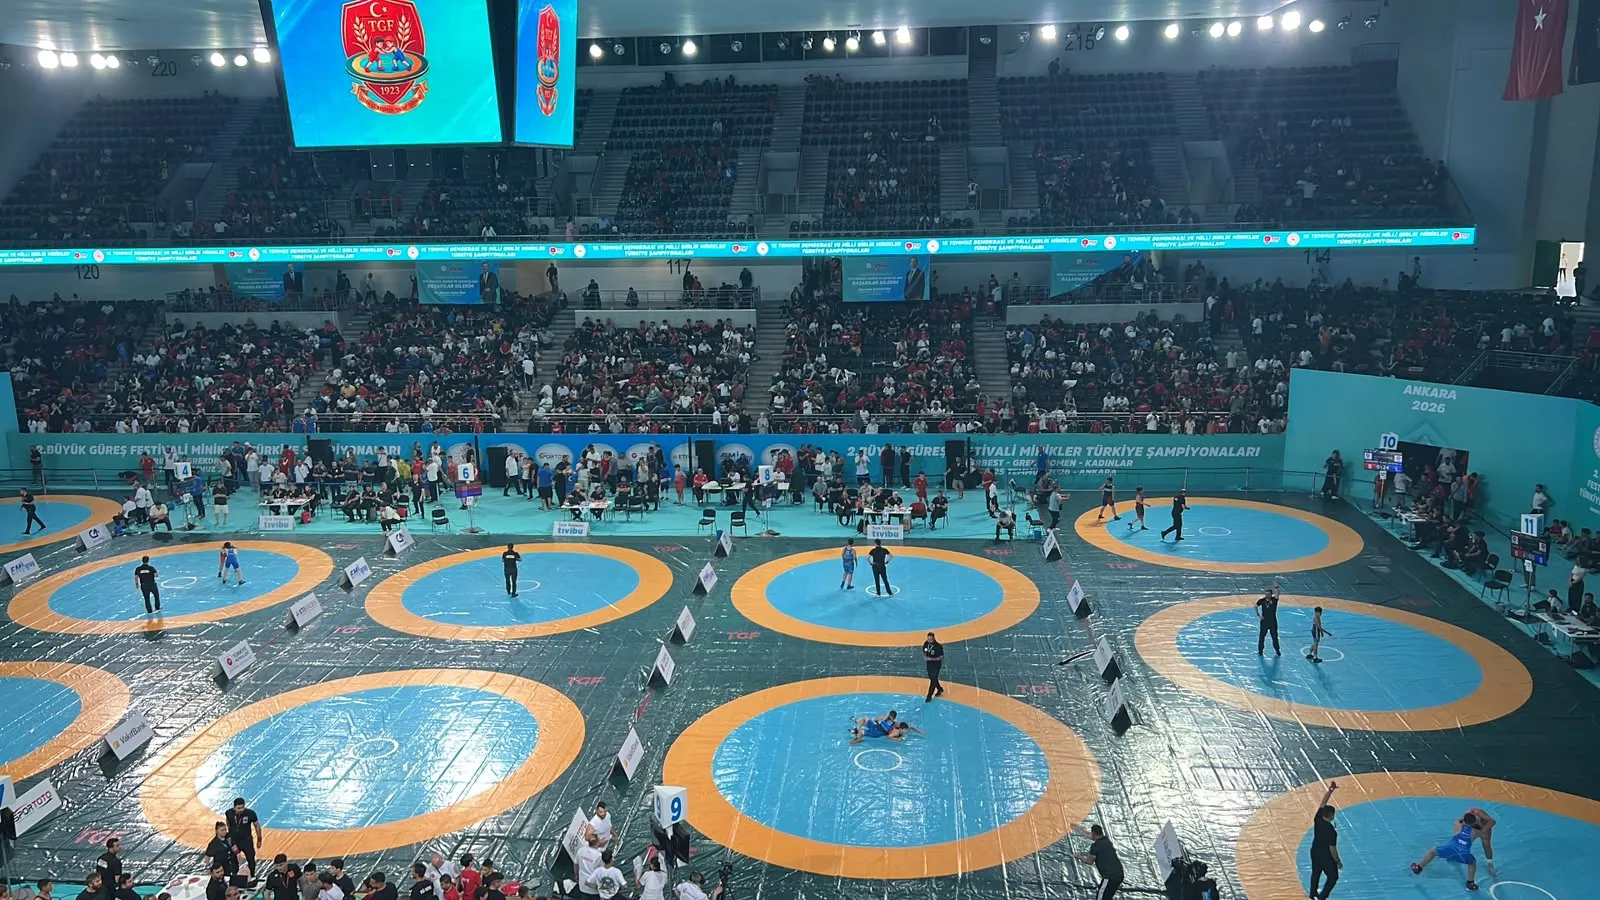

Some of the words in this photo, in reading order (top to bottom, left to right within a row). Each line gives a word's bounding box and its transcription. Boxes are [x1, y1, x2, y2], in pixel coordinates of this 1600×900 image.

[368, 20, 394, 32] TGF
[1064, 32, 1094, 50] 215
[152, 62, 177, 76] 220
[380, 86, 400, 96] 1923
[75, 264, 99, 279] 120
[667, 259, 691, 274] 117
[1403, 385, 1456, 400] ANKARA
[1412, 401, 1446, 413] 2026
[1383, 436, 1396, 448] 10
[89, 444, 127, 457] GÜREŞ
[847, 444, 902, 456] 2.BÜYK
[908, 444, 945, 458] GÜREŞ
[1086, 444, 1143, 456] TÜRKİYE
[1146, 444, 1260, 459] ŞAMPİYONALARI
[183, 465, 188, 475] 4
[462, 467, 468, 479] 6
[764, 469, 770, 481] 8
[1525, 518, 1533, 534] 11
[568, 676, 605, 685] TGF
[1017, 685, 1057, 694] TGF
[671, 797, 682, 822] 9
